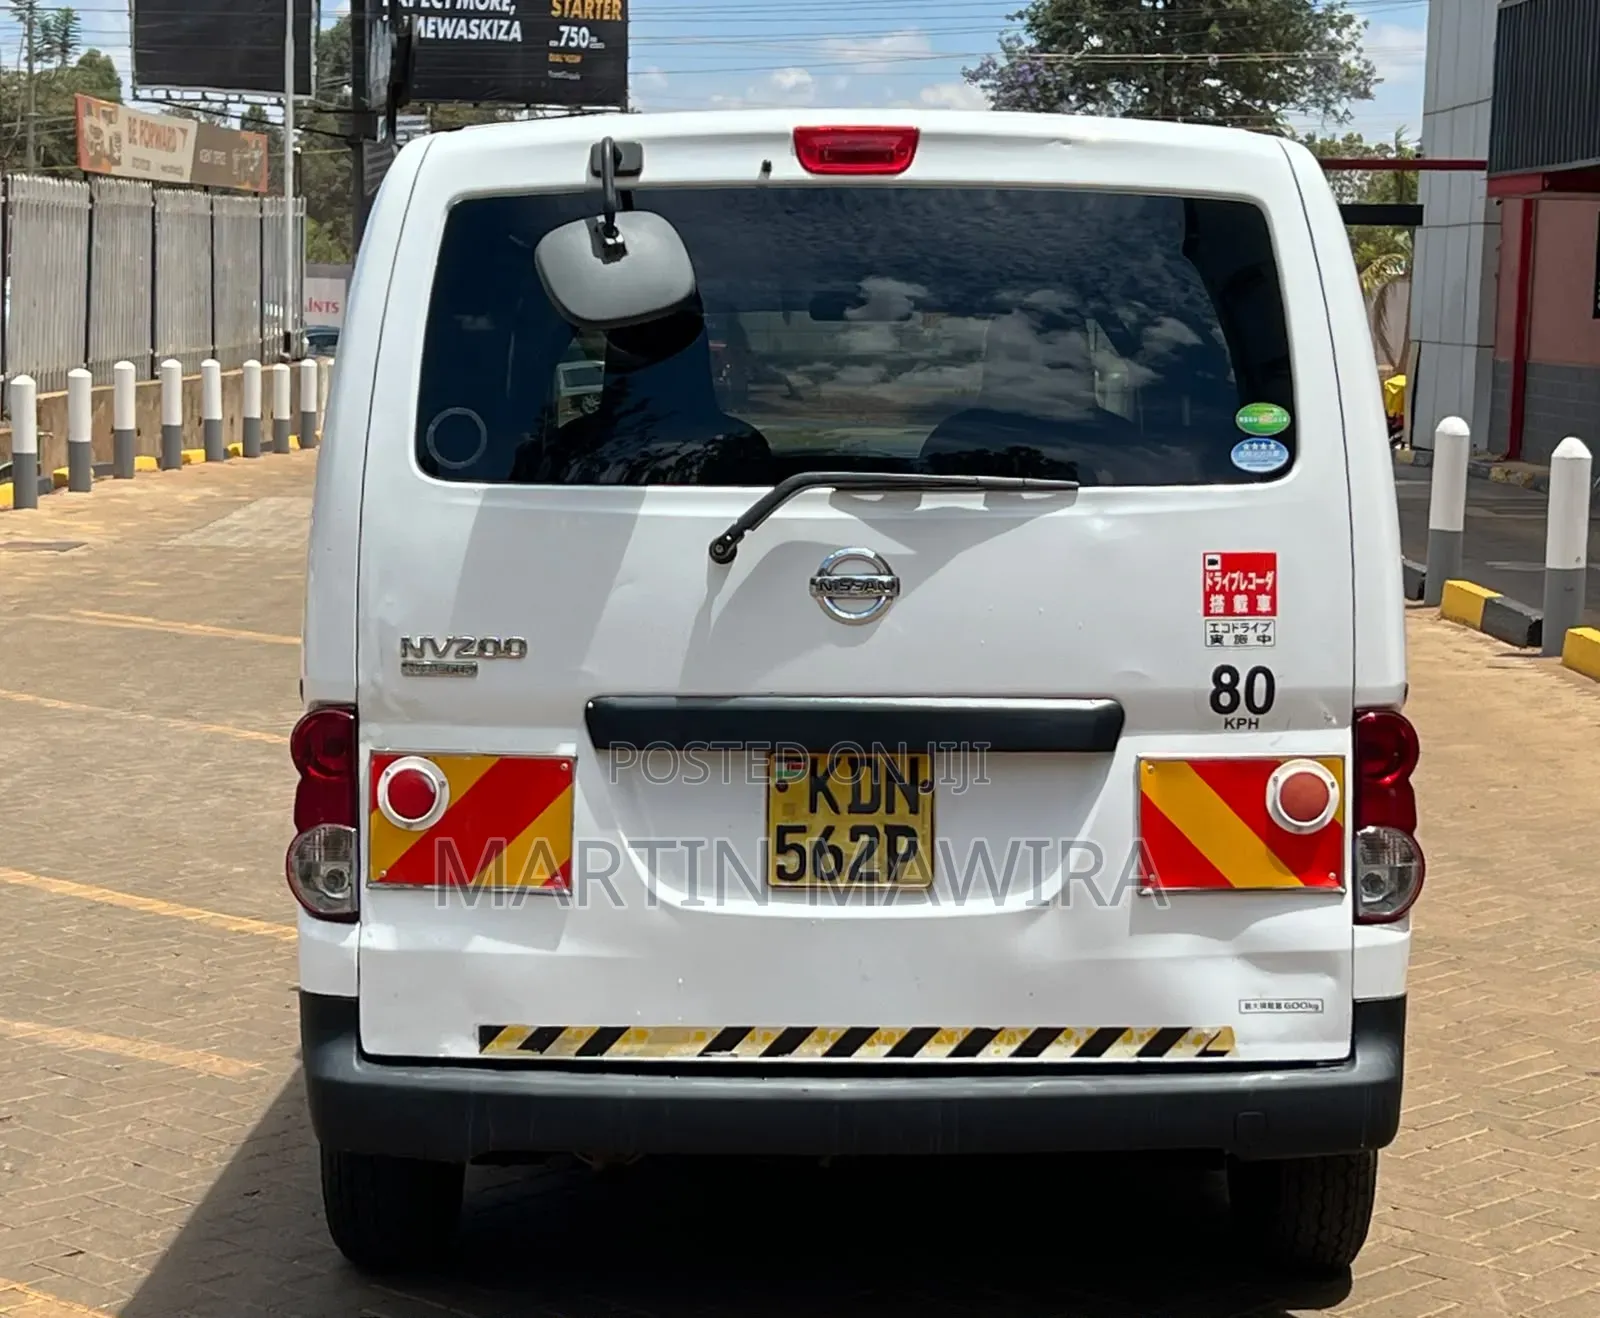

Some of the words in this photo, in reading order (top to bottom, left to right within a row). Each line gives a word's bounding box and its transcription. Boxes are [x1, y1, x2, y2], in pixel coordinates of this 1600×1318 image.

[551, 0, 622, 20] STARTER
[402, 15, 522, 41] MEWASKIZA
[559, 25, 590, 48] 750
[819, 579, 892, 592] NISSAN
[1205, 571, 1275, 593] ドライブレコーダ
[1209, 622, 1272, 634] エコドライブ
[401, 635, 527, 659] NV200
[1210, 664, 1275, 715] 80
[1223, 717, 1260, 730] KPH
[808, 757, 920, 815] KDN
[775, 824, 920, 882] 562P
